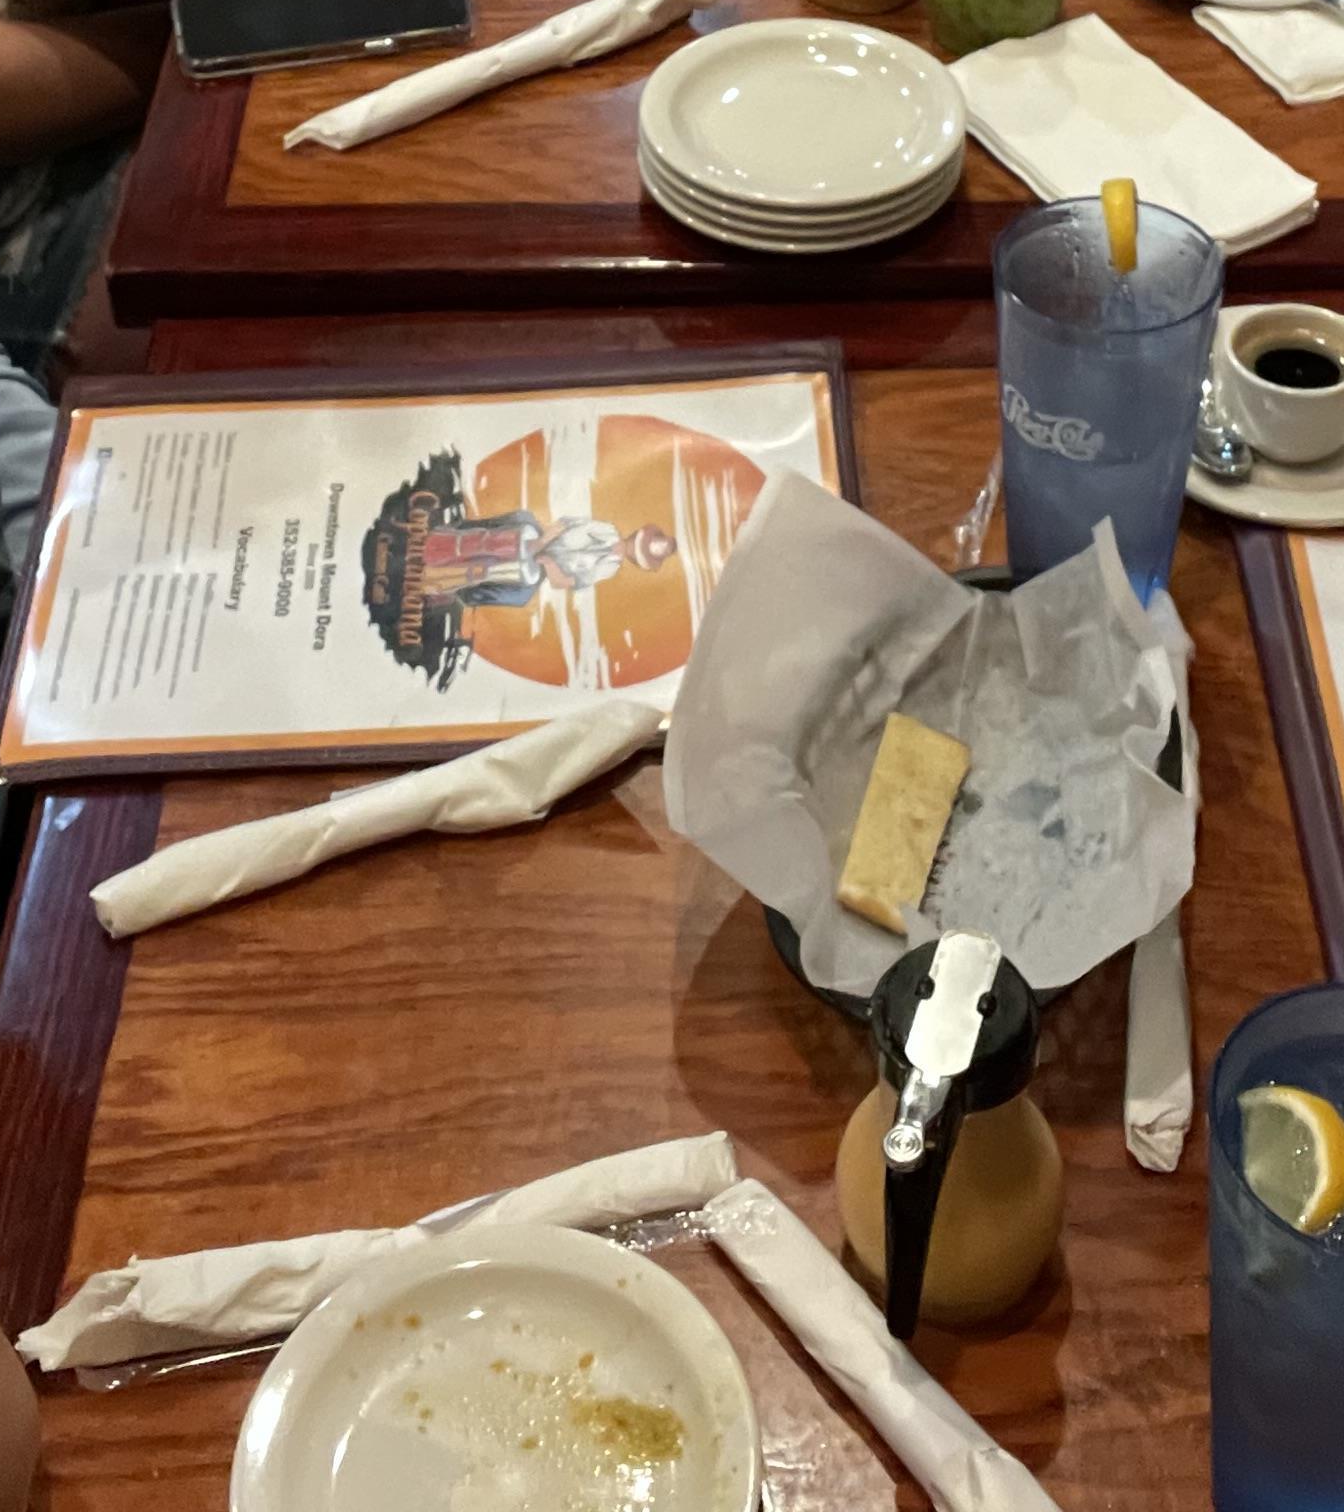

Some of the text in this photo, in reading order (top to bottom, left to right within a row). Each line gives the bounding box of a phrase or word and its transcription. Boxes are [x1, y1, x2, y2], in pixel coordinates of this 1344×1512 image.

[224, 526, 254, 611] Vocabulary
[312, 483, 344, 650] Downtown Mount Dora
